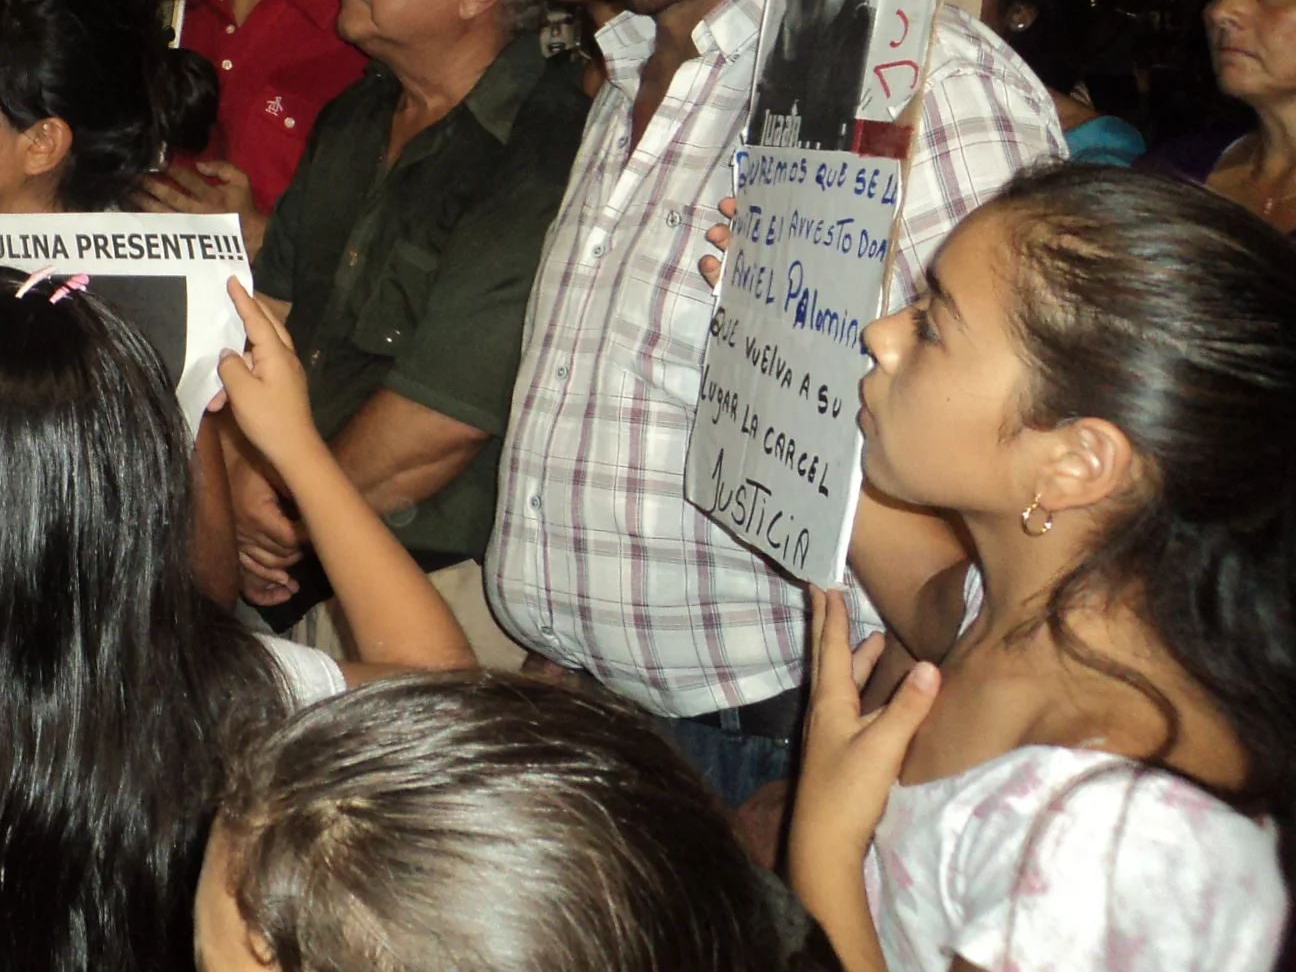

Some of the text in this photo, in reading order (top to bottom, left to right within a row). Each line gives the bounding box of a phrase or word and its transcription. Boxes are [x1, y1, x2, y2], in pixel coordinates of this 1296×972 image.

[815, 162, 848, 191] QUE
[854, 168, 881, 199] SE
[77, 233, 245, 261] PRESENTE!!!
[709, 306, 739, 348] QUE
[799, 372, 811, 401] A
[817, 383, 843, 419] SU
[741, 403, 760, 440] LA
[762, 426, 830, 498] CARCEL
[706, 447, 811, 570] JUSTICIA
